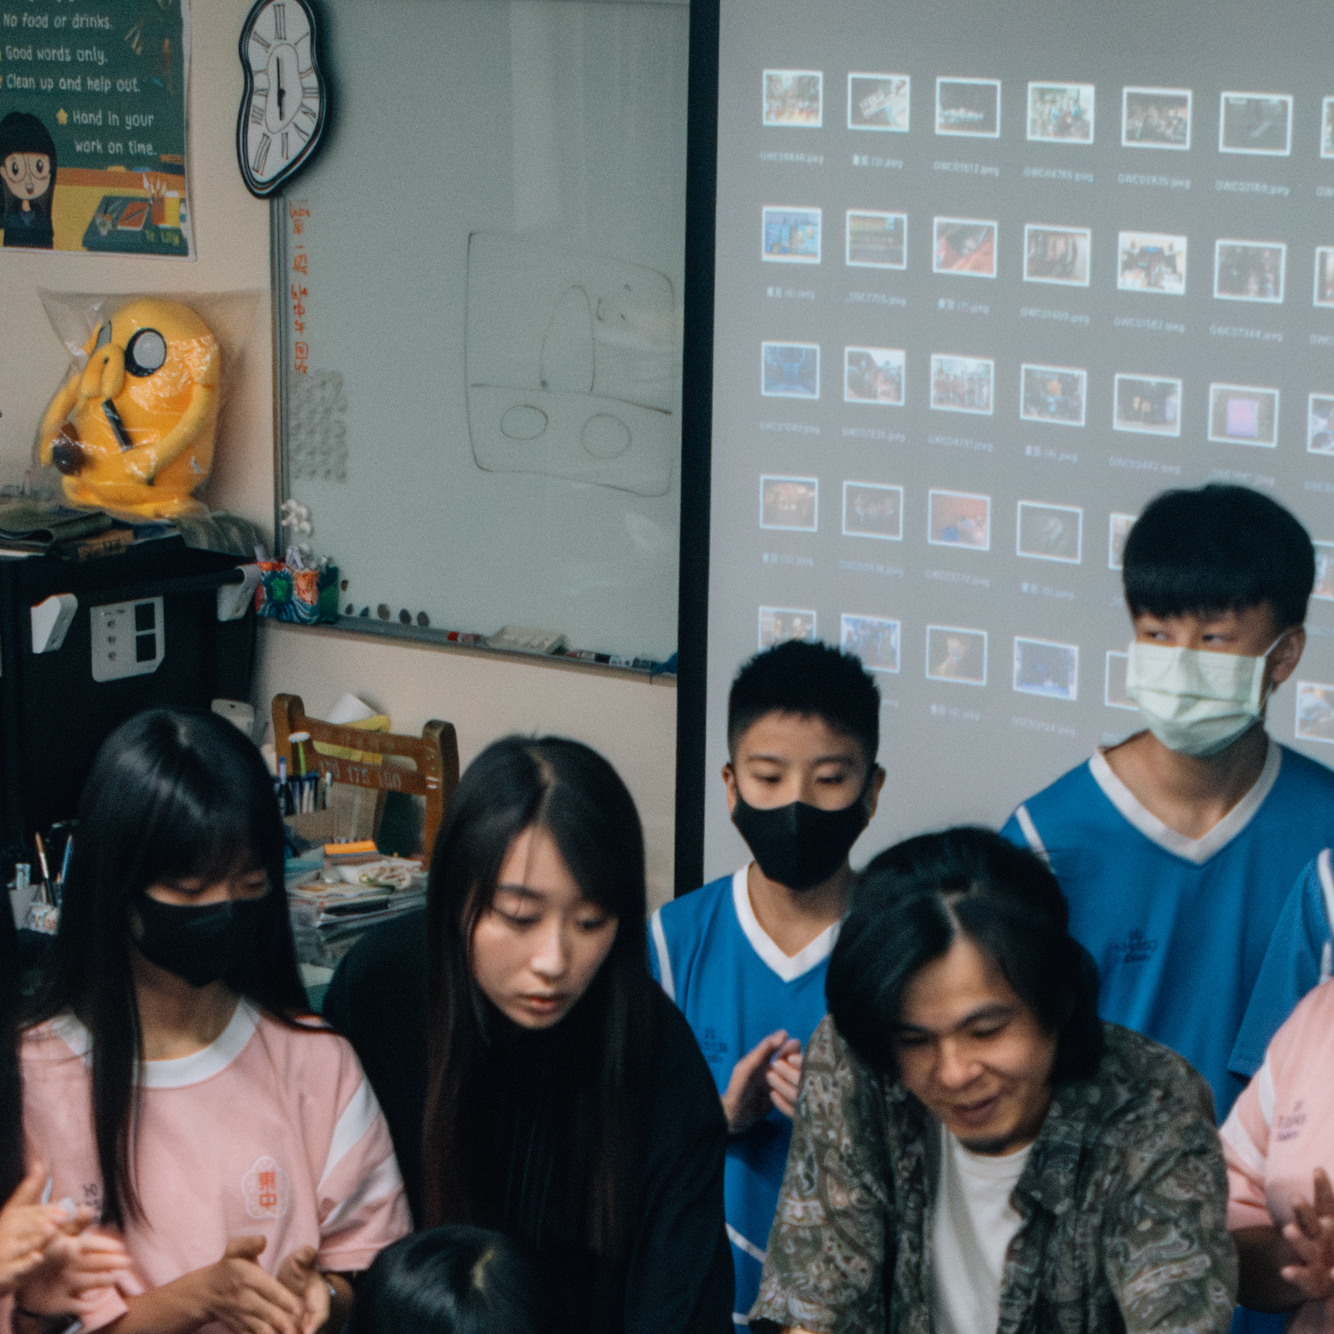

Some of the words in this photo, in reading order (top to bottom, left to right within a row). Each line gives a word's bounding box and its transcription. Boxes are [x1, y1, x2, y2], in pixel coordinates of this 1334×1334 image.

[3, 13, 17, 27] No
[22, 13, 48, 28] food
[53, 16, 66, 27] or
[72, 13, 113, 29] drinks.
[5, 45, 33, 61] Good
[37, 46, 71, 62] words
[6, 74, 35, 89] Clean
[40, 77, 54, 92] up
[59, 75, 82, 90] and
[87, 76, 111, 93] help
[73, 109, 103, 126] Hand
[125, 114, 154, 130] your
[74, 139, 103, 154] work
[108, 141, 123, 154] on
